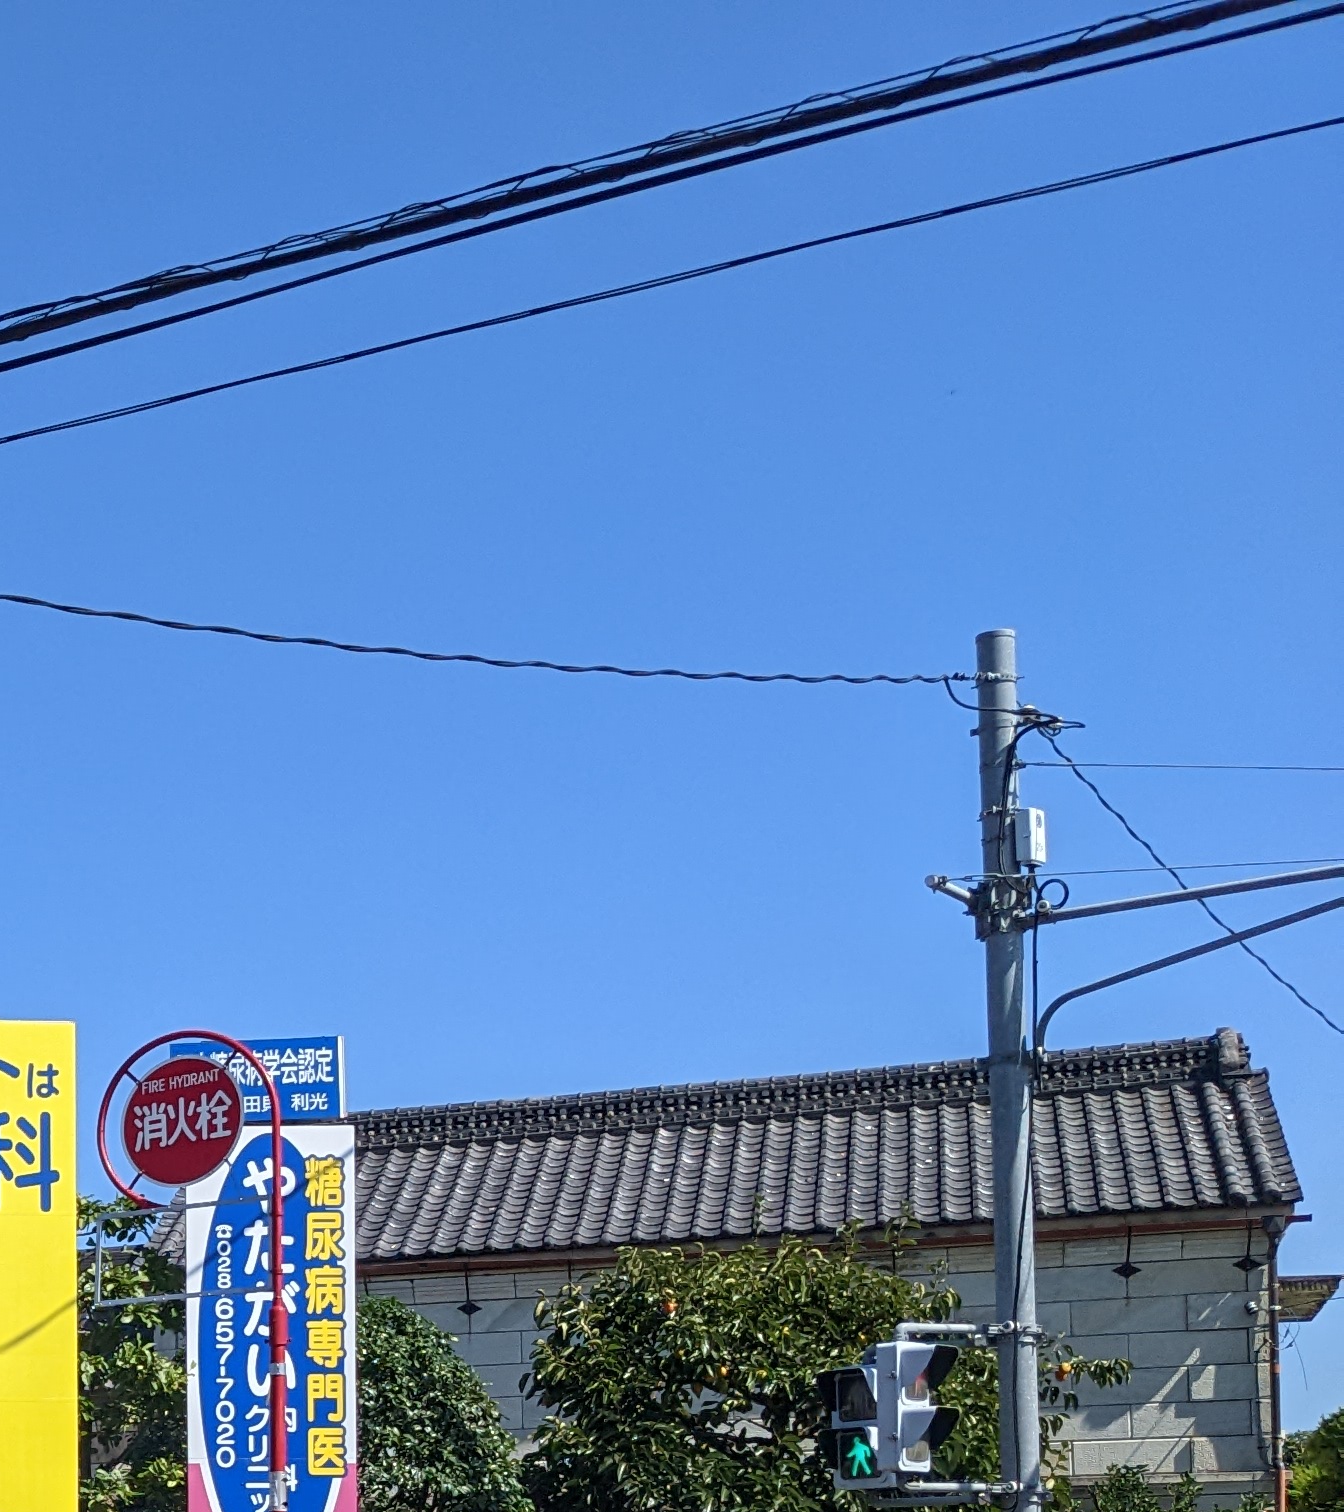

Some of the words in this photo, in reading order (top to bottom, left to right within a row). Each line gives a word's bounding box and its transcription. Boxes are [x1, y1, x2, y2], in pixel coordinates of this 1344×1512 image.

[142, 1079, 165, 1095] FIRE
[169, 1069, 219, 1091] HYDRANT
[291, 1093, 328, 1111] 利光
[133, 1089, 232, 1152] 消火栓
[305, 1155, 346, 1476] 糖尿病専門医
[215, 1240, 235, 1468] 028657-7020
